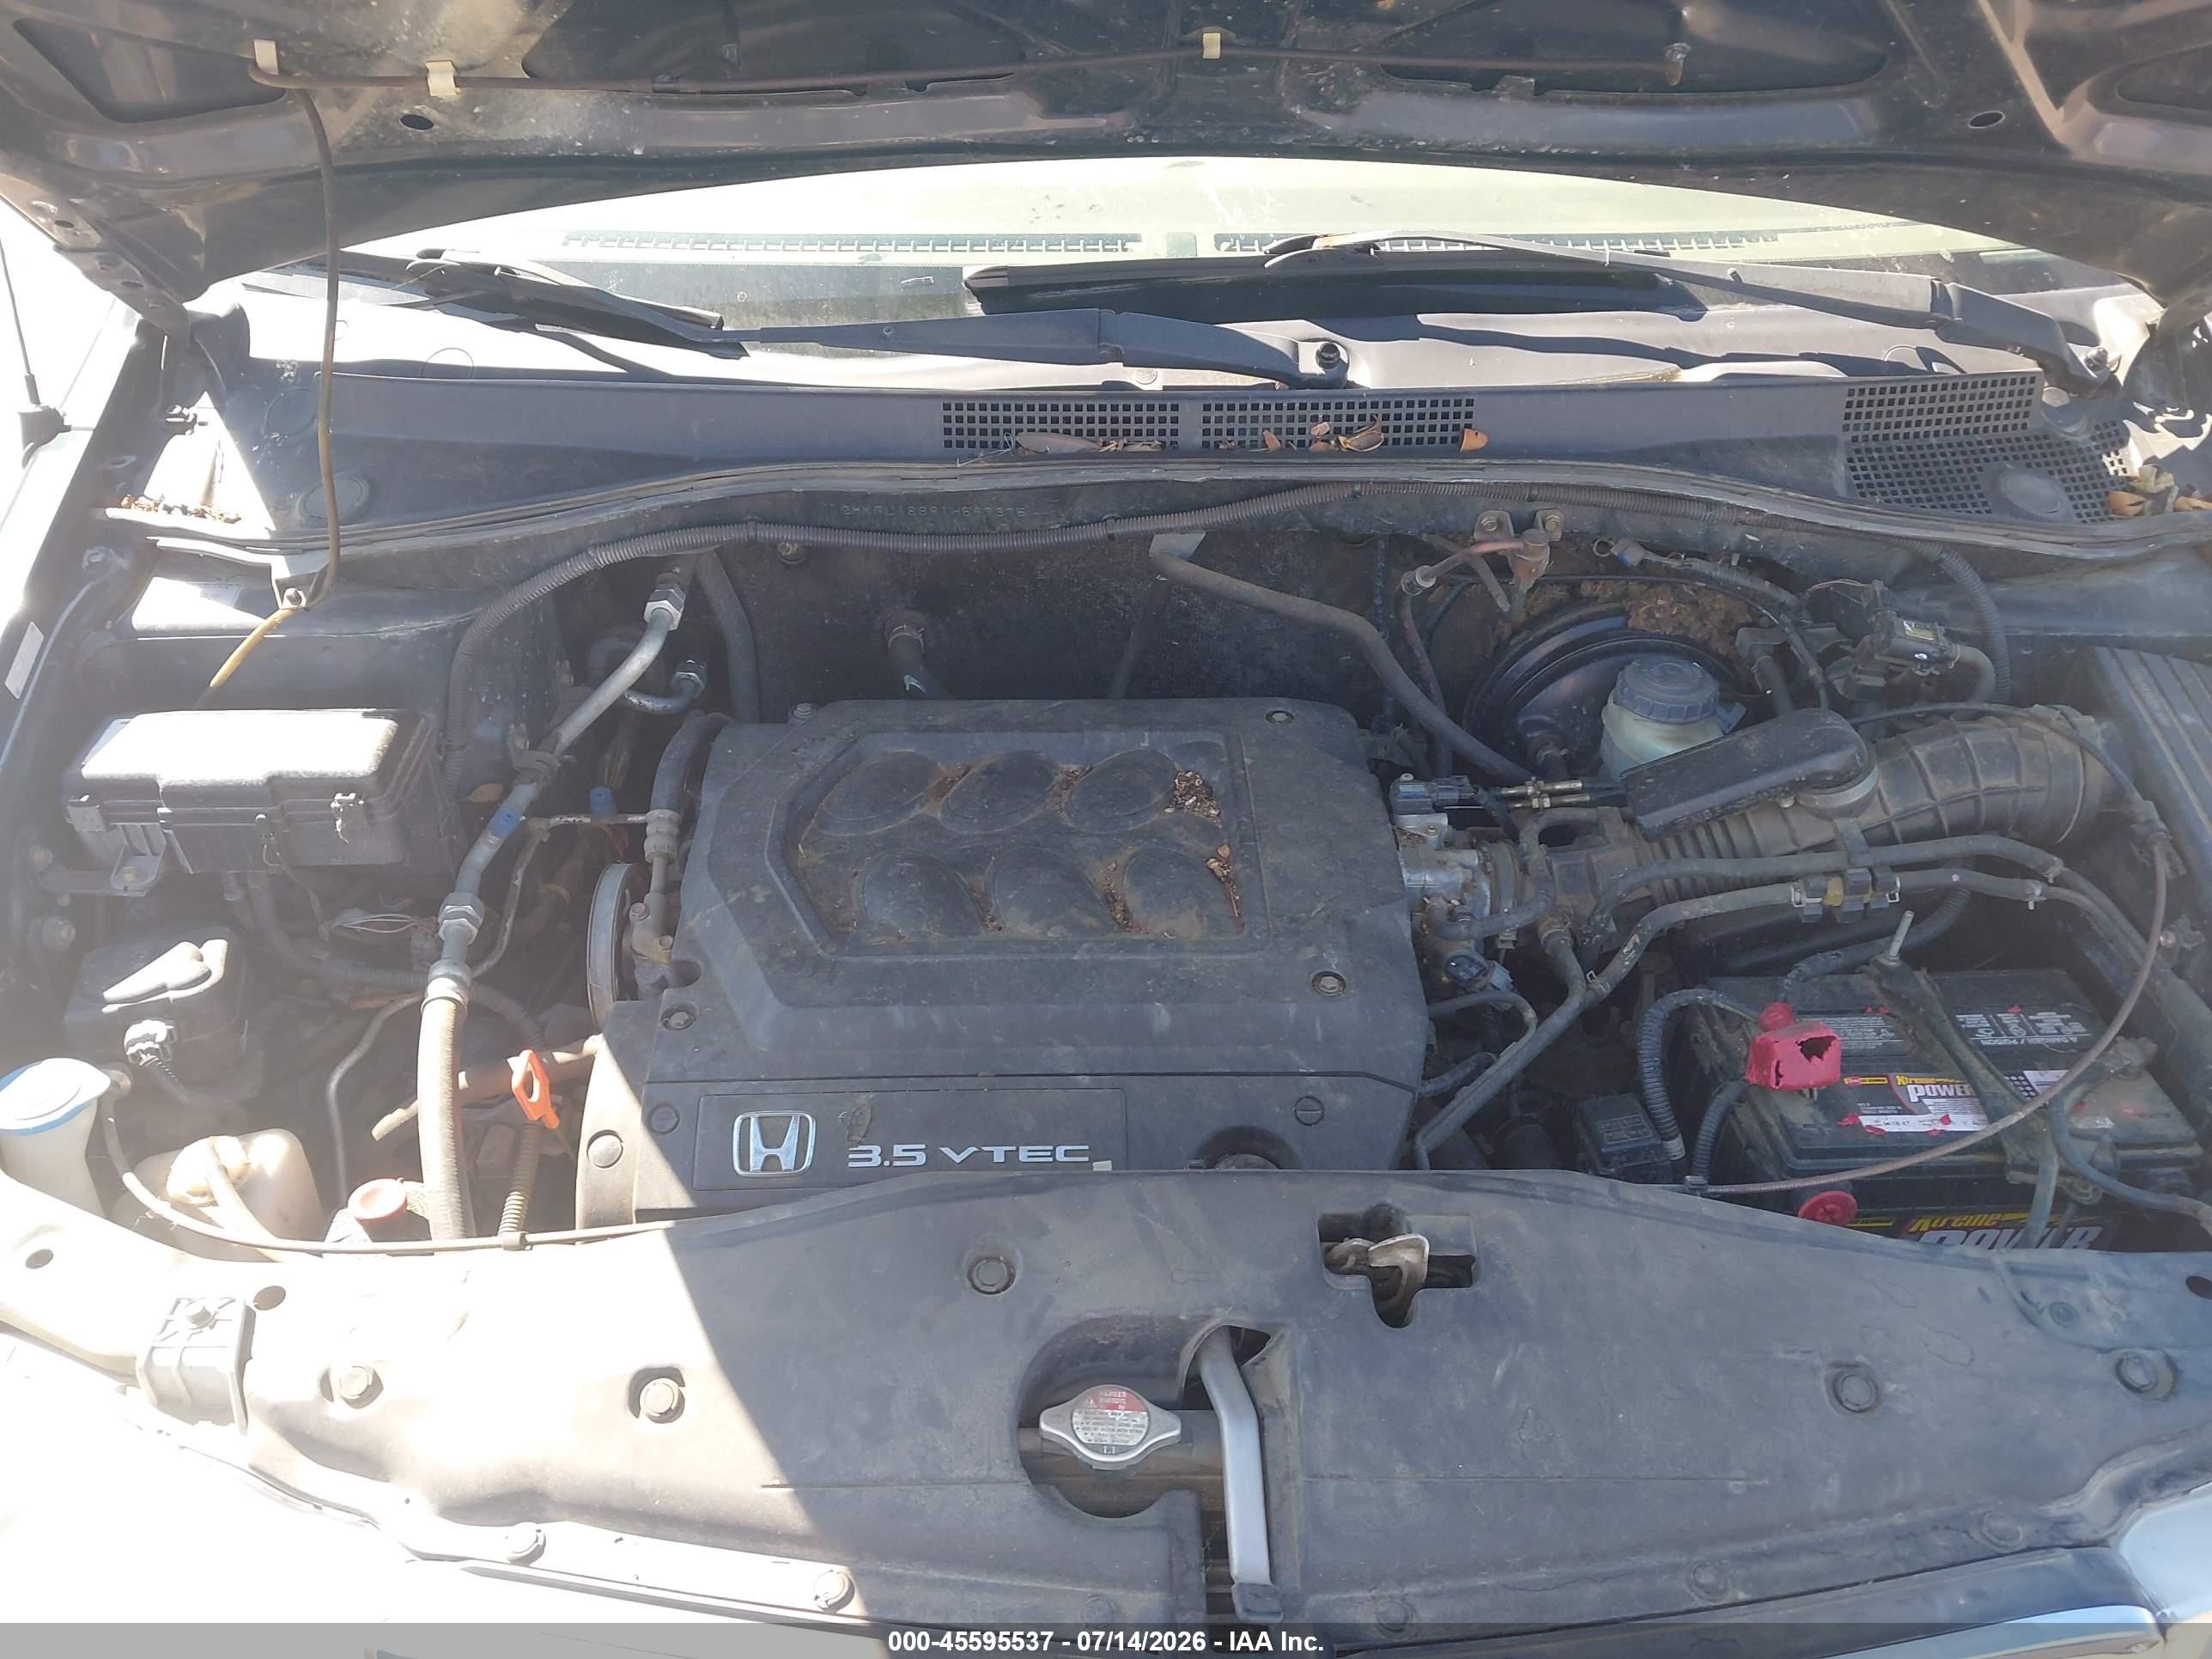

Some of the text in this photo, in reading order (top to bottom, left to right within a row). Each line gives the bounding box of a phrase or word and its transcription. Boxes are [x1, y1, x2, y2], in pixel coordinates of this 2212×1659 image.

[1906, 1085, 1976, 1103] POWER
[848, 1144, 1090, 1168] 3.5 VTEC
[1909, 1212, 2002, 1232] Xtreme
